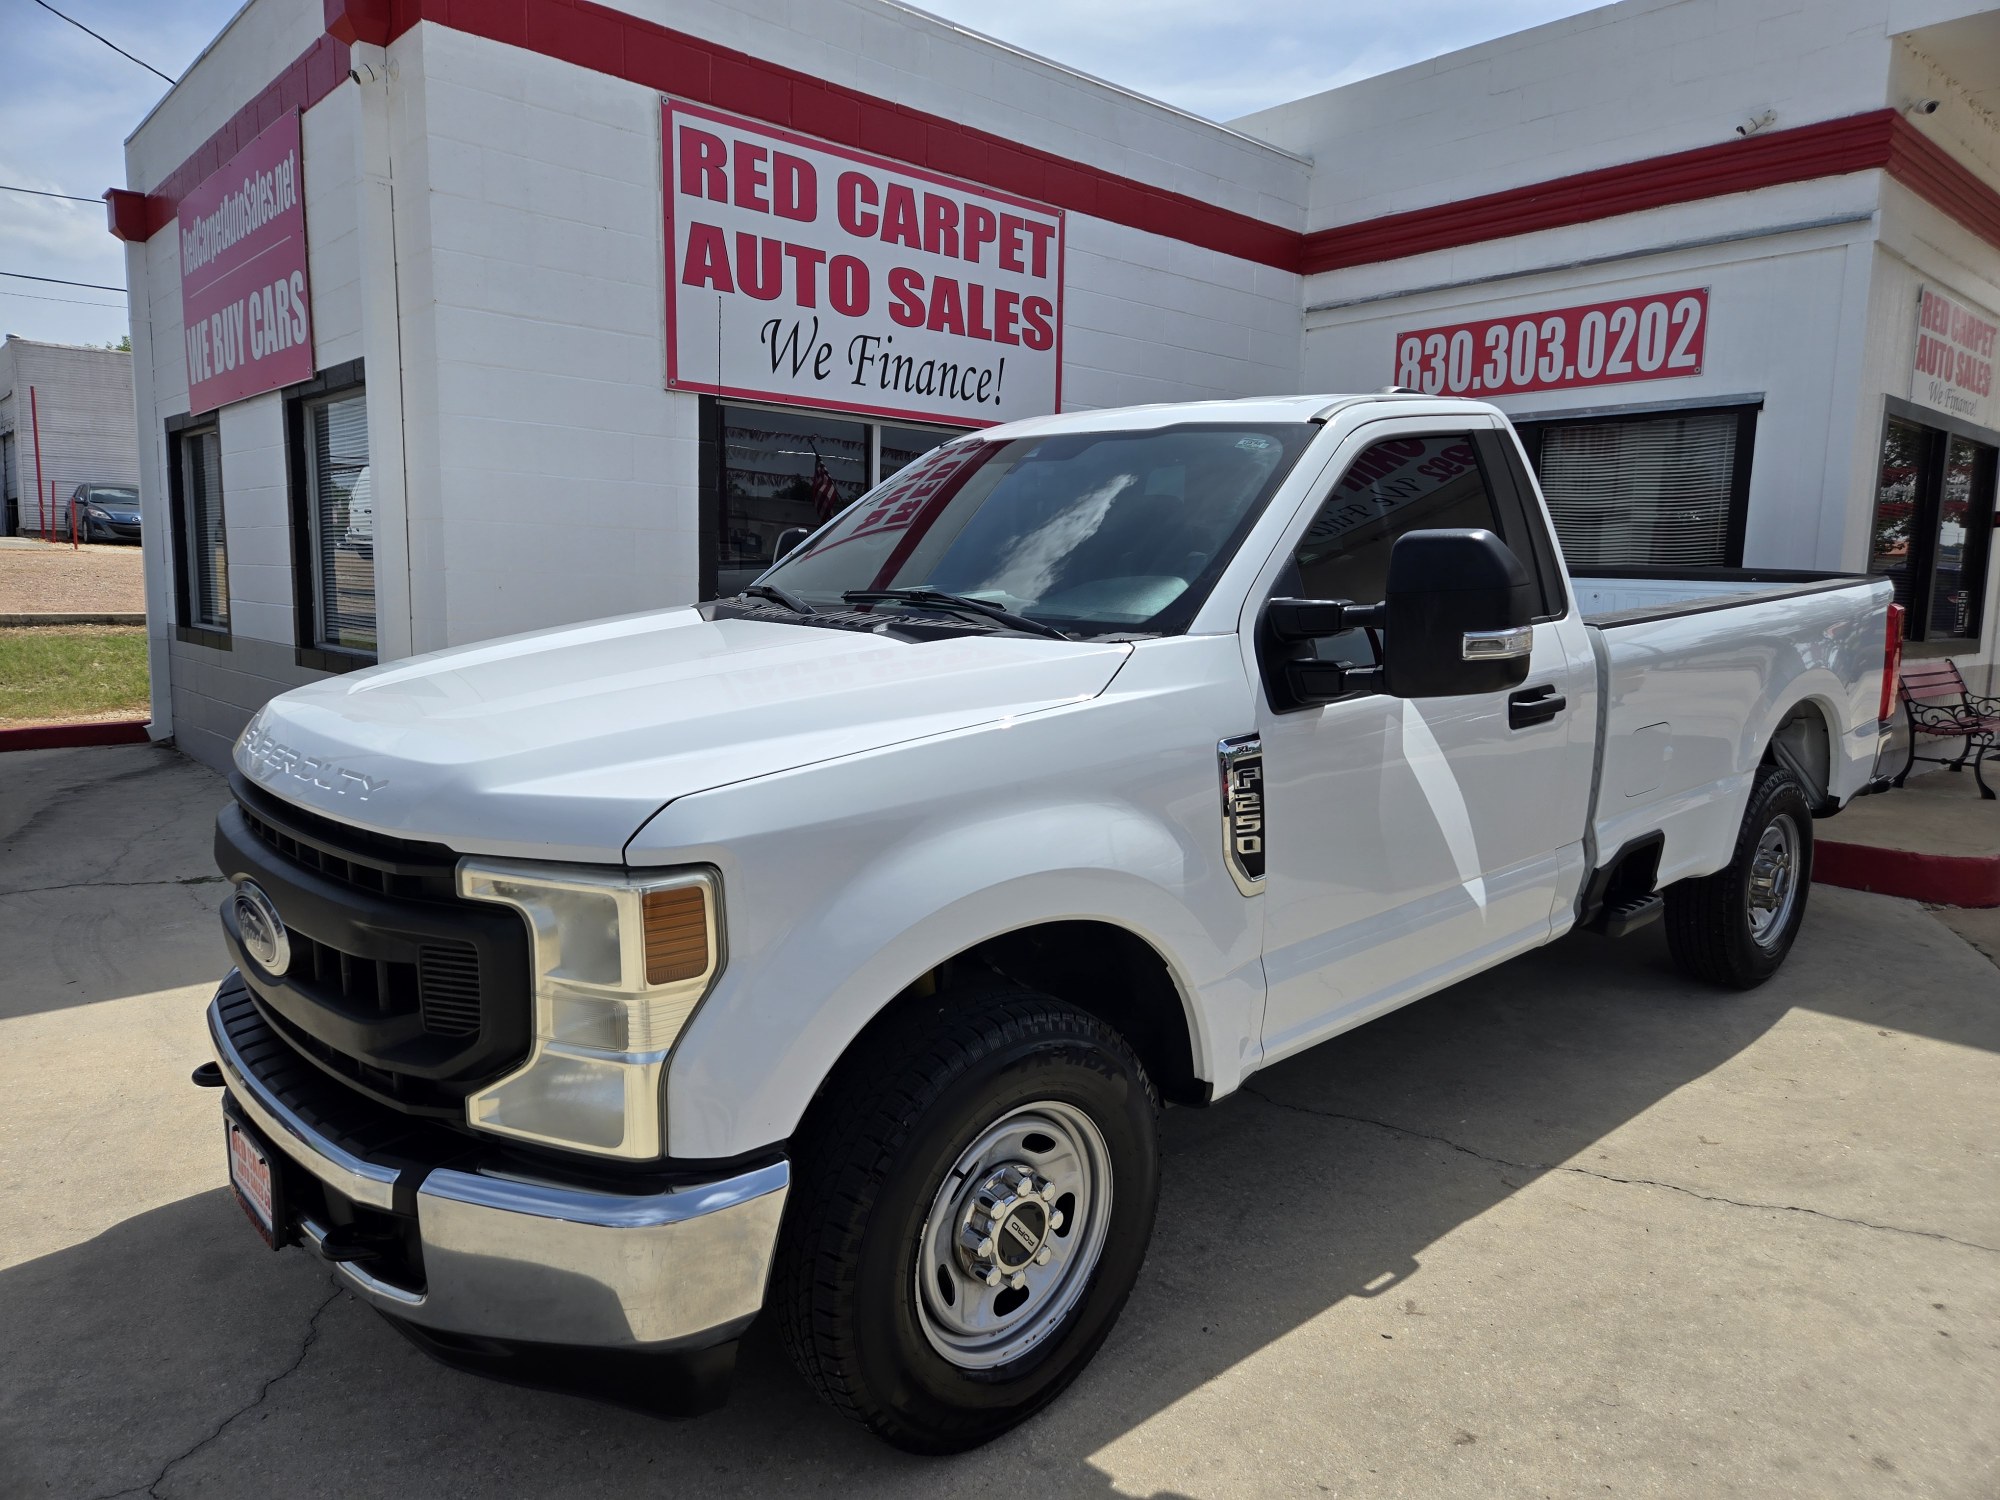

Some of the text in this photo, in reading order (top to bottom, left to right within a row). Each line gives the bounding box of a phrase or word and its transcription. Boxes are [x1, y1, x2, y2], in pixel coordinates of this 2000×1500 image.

[182, 149, 297, 277] RedCarpetAutoSales.net
[679, 124, 1056, 279] RED CARPET
[186, 270, 307, 386] WE BUY CARS
[681, 221, 1054, 352] AUTO SALES
[1920, 290, 1997, 358] RED CARPET
[760, 315, 1005, 406] We Finance!
[1399, 297, 1701, 395] 830.303.0202
[1915, 333, 1992, 398] AUTO SALES
[1928, 380, 1978, 417] We Finance!
[239, 905, 264, 952] Ford
[1011, 1221, 1036, 1247] FORD
